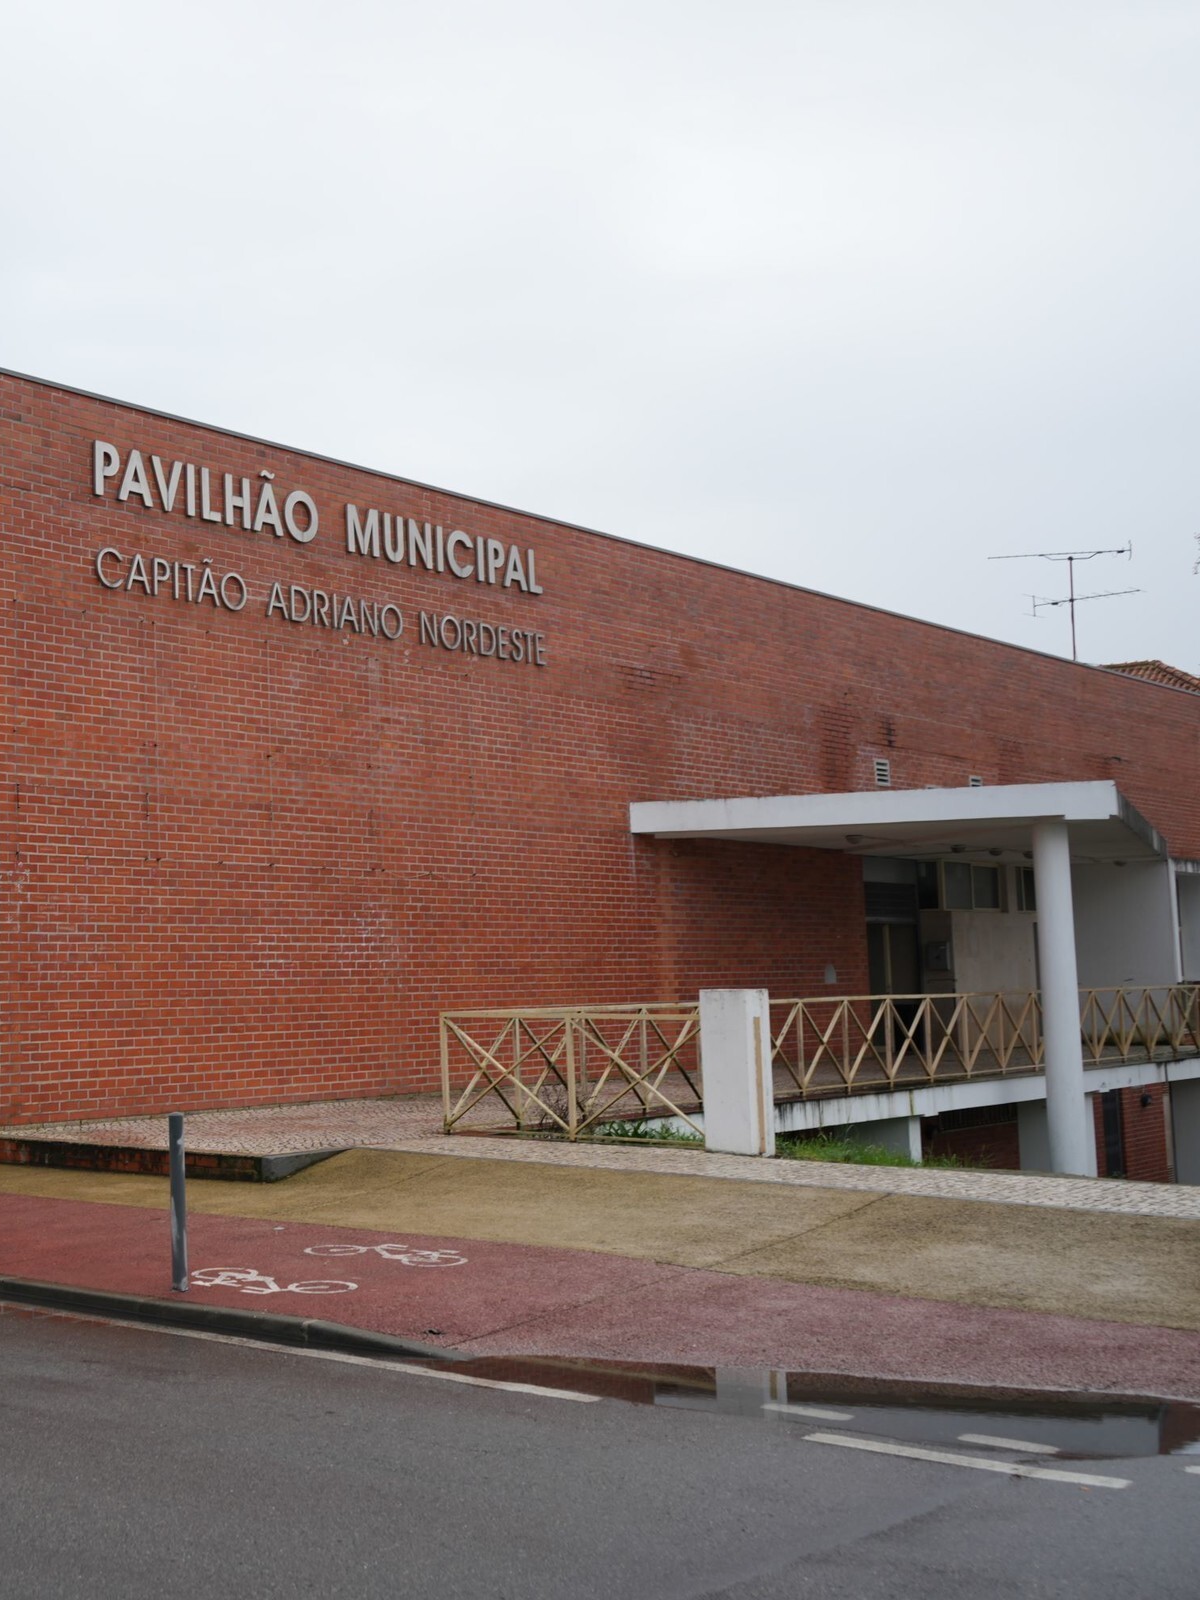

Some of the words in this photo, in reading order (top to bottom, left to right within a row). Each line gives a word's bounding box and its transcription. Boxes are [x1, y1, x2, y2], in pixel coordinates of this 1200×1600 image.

[93, 440, 319, 543] PAVILHÃO
[345, 503, 544, 595] MUNICIPAL
[96, 547, 248, 611] CAPITÃO
[267, 581, 403, 640] ADRIANO
[420, 610, 547, 666] NORDESTE
